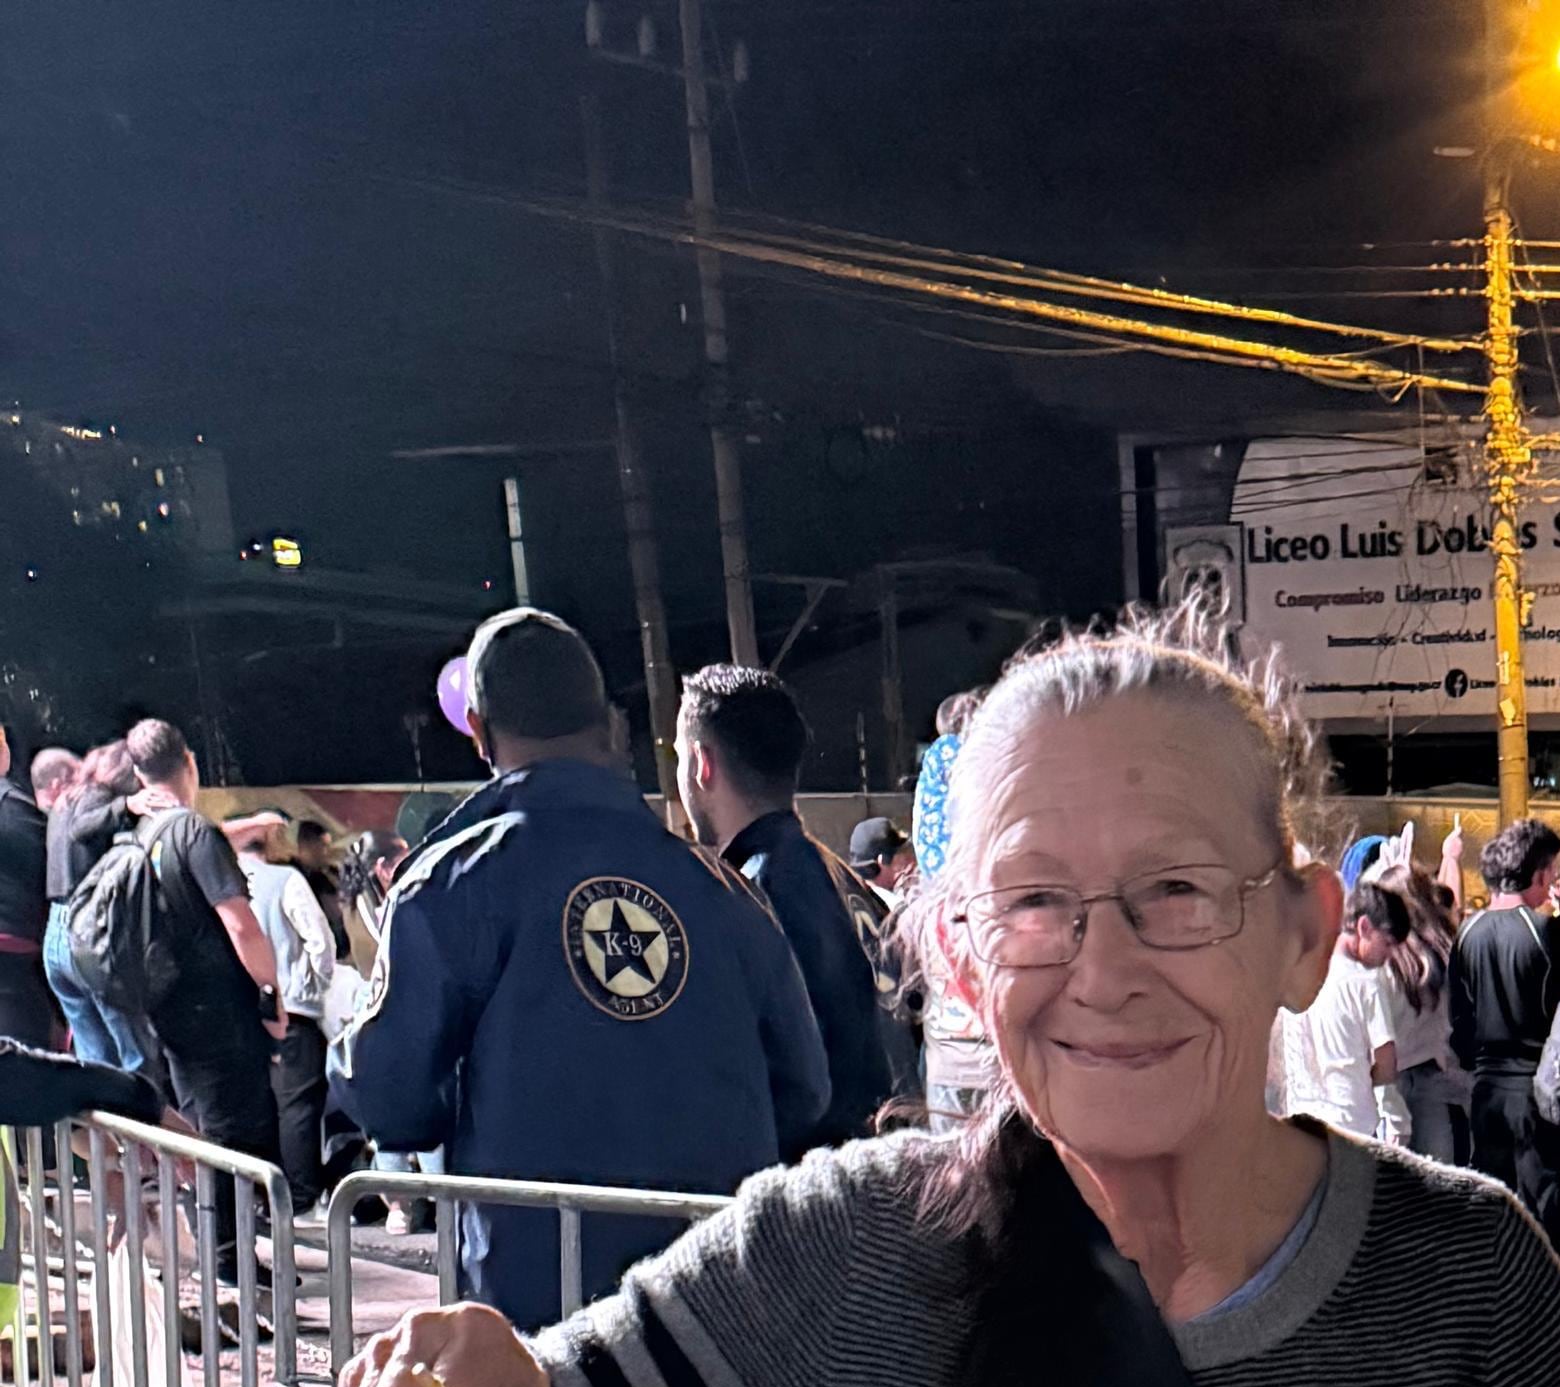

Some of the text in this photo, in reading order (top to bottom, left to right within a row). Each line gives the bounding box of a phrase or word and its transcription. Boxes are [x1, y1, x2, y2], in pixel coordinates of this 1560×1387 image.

[1247, 525, 1329, 563] Liceo
[1341, 520, 1403, 559] Luis
[1417, 513, 1537, 556] Dobs
[1275, 586, 1385, 612] Compromiso
[1396, 584, 1482, 606] Liderazgo
[603, 931, 642, 957] K-9
